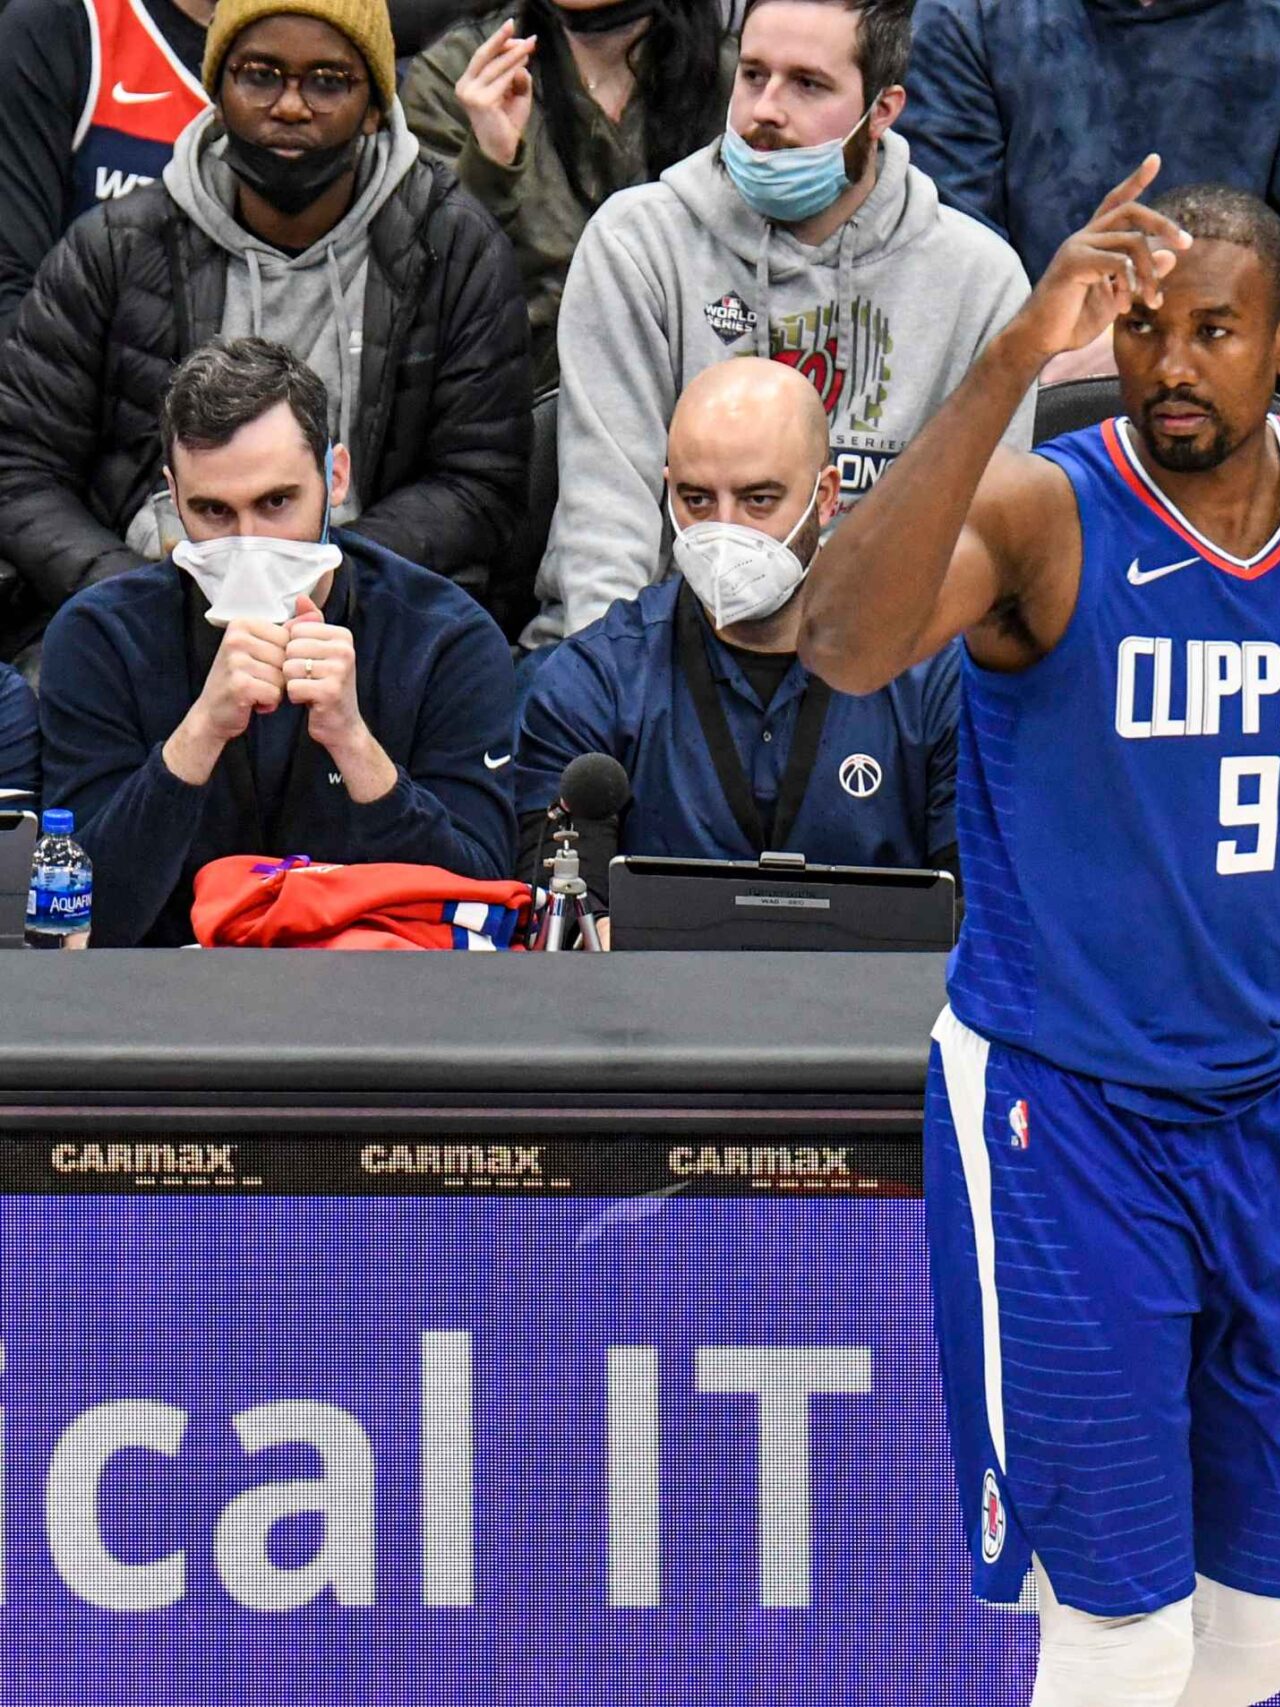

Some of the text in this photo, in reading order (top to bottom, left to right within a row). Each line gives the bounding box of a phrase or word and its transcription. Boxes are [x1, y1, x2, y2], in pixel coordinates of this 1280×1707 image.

[704, 303, 757, 322] WORLD
[707, 314, 753, 332] SERIES
[1216, 755, 1280, 875] 9
[0, 1330, 474, 1612] cal
[607, 1345, 872, 1607] IT
